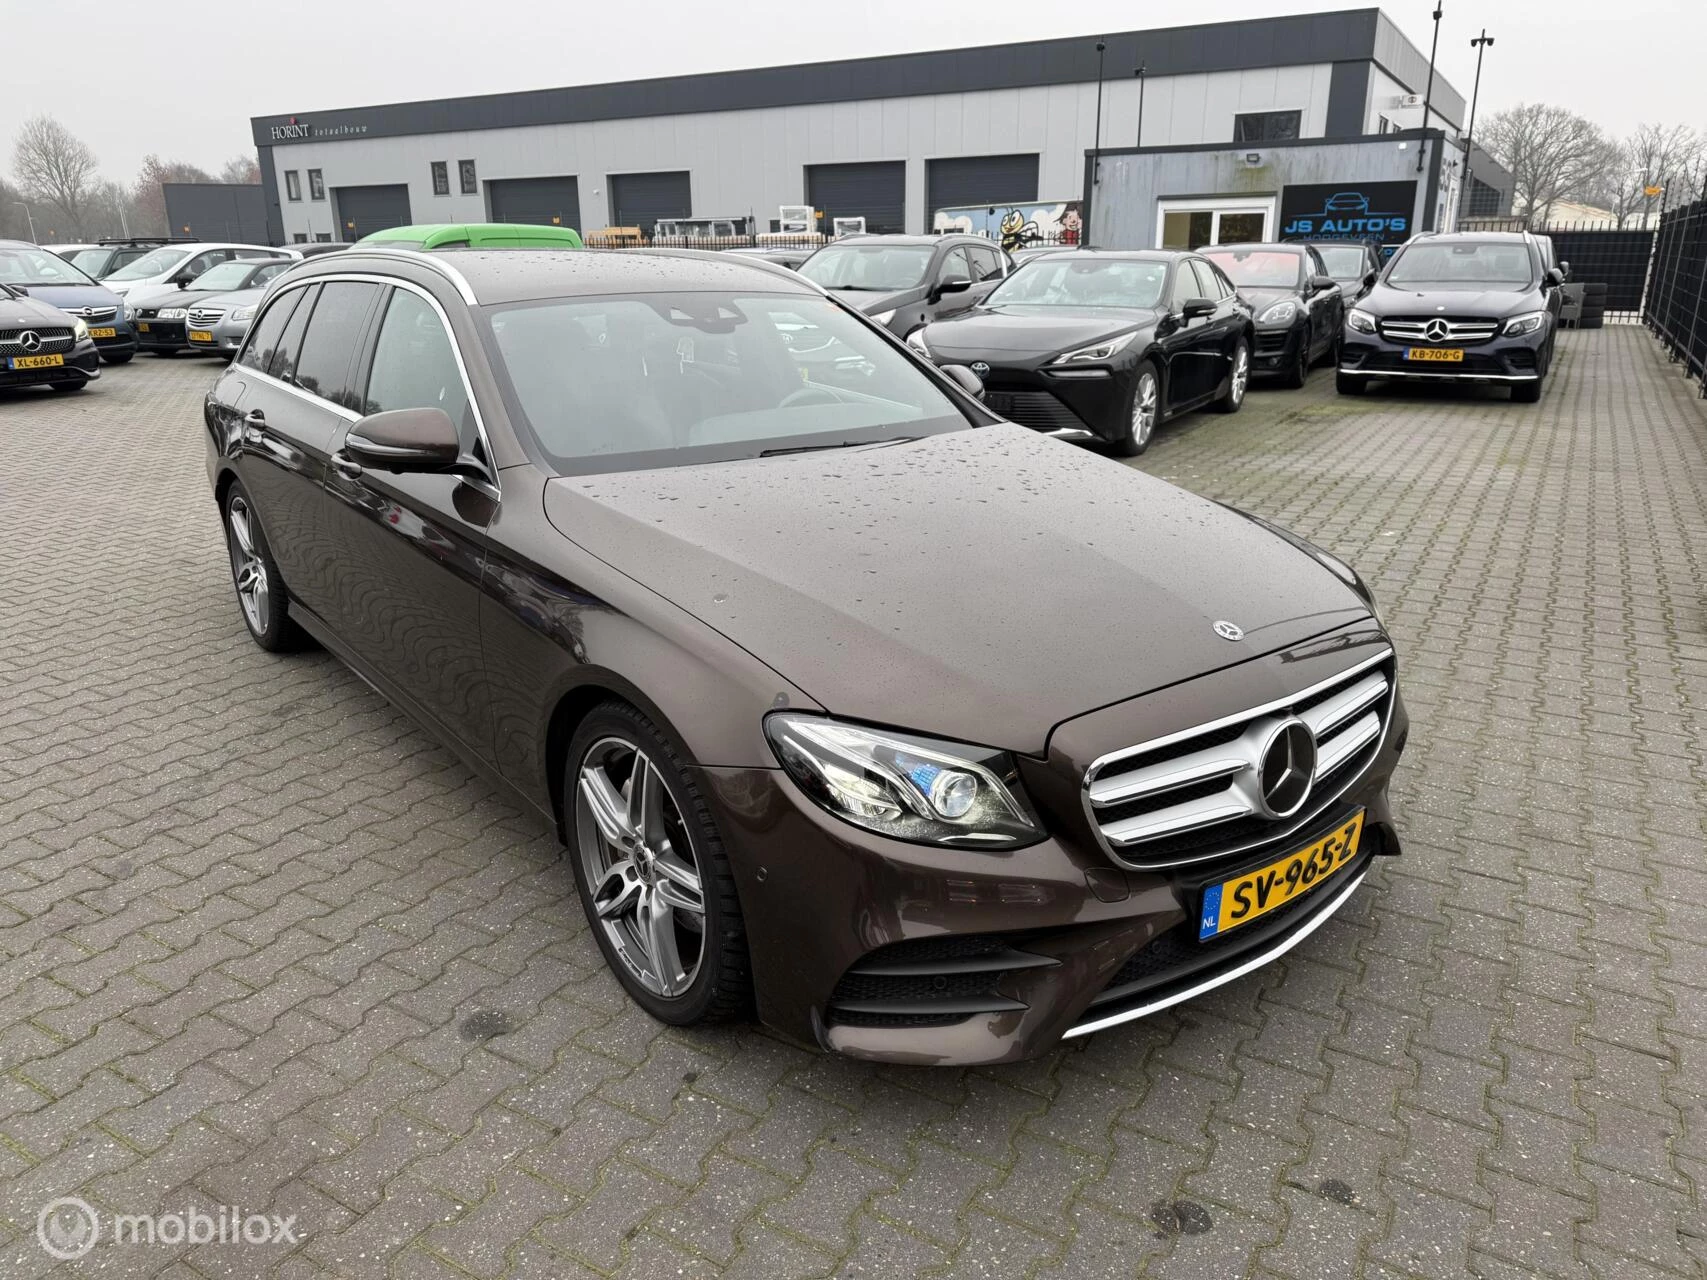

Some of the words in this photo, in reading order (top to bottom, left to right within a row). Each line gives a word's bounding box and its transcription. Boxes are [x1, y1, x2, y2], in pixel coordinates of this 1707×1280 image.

[271, 124, 309, 139] HORINT
[1285, 220, 1313, 233] JS
[1320, 217, 1406, 232] AUTO'S
[88, 328, 114, 337] KRZ-53
[16, 355, 61, 369] XL-660-L
[1412, 350, 1461, 360] KB-706-G
[1231, 822, 1358, 919] SV-965-Z
[1202, 914, 1217, 930] NL
